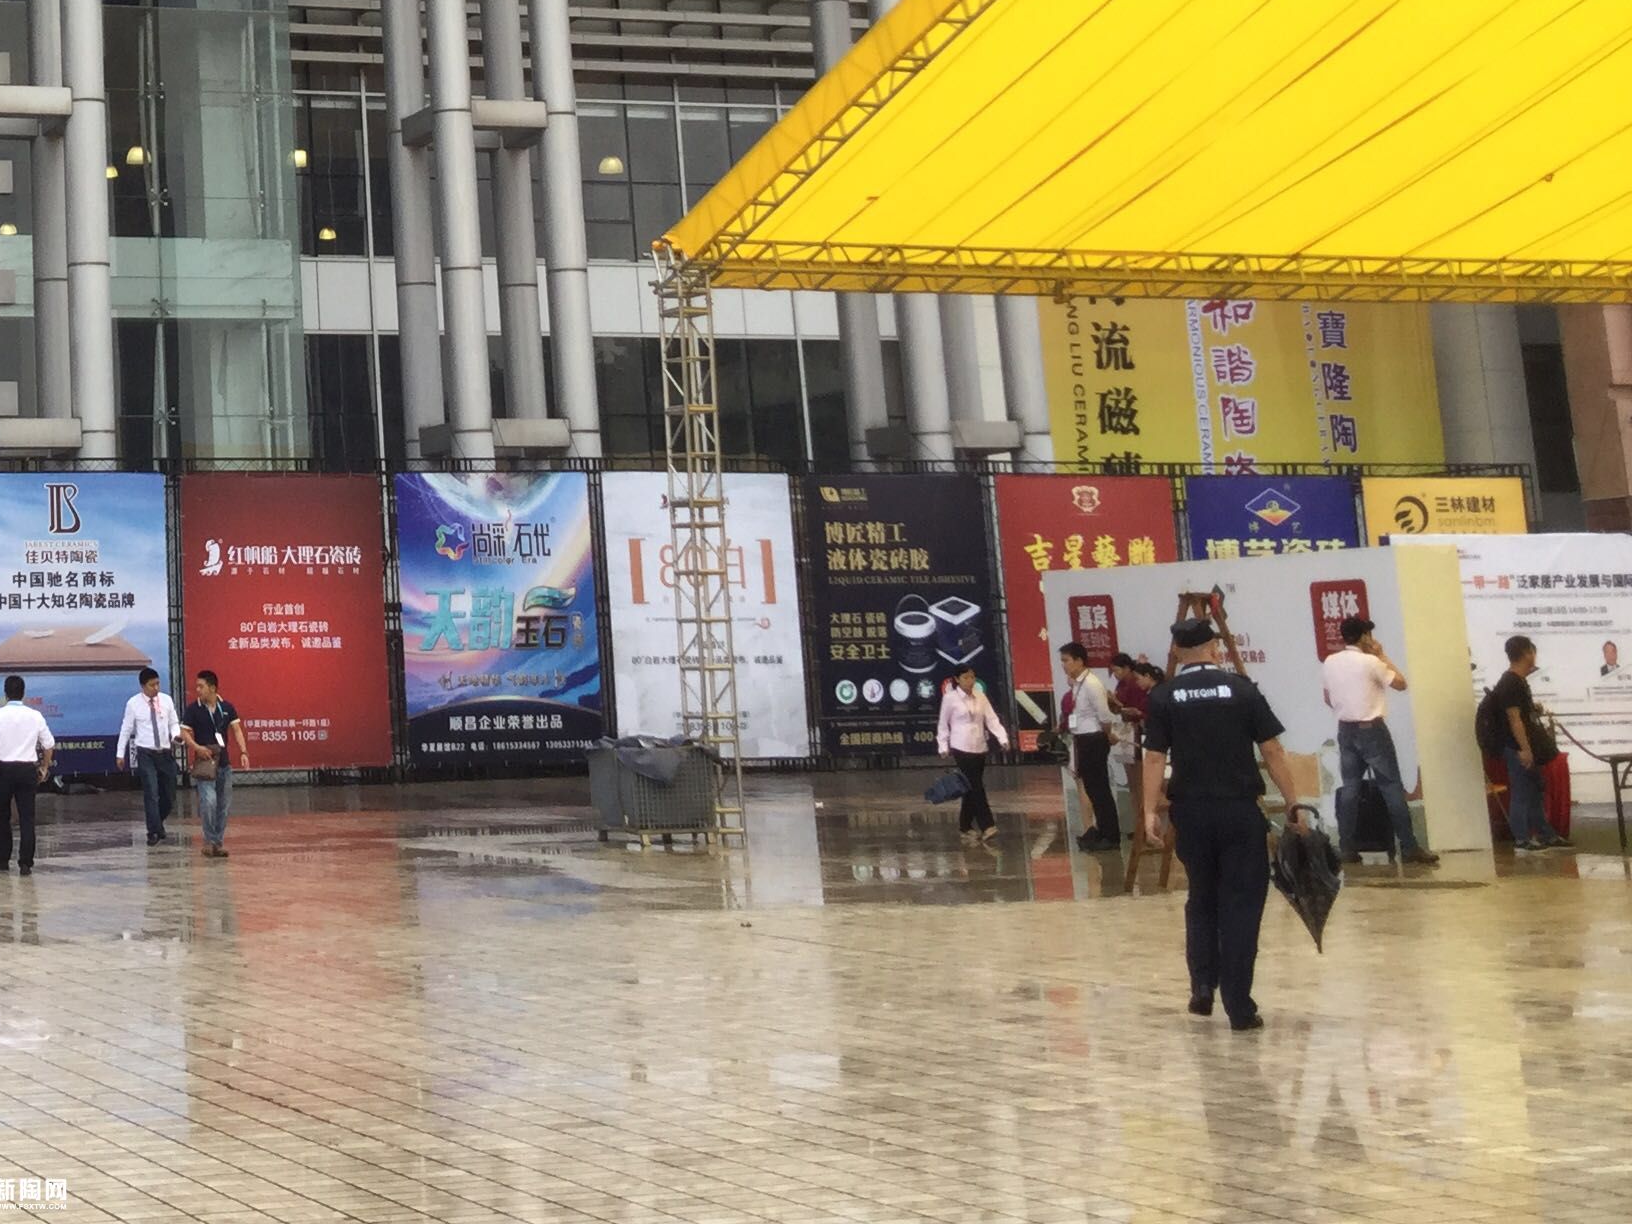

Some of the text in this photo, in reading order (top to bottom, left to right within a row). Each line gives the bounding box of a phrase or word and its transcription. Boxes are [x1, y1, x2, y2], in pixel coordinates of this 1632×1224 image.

[1069, 342, 1083, 376] LIU
[1434, 495, 1496, 513] 三林建材
[824, 521, 908, 544] 博匠精工
[25, 550, 99, 564] 佳贝特陶瓷
[227, 544, 363, 566] 红帆船 大理石瓷砖
[826, 547, 931, 571] 液体瓷砖胶
[12, 571, 116, 588] 中国驰名商标
[262, 604, 305, 616] 行业首创
[1320, 590, 1360, 620] 媒体
[829, 612, 862, 624] 大理石
[1076, 604, 1109, 630] 嘉宾
[830, 643, 892, 661] 安全卫士
[448, 714, 564, 732] 顺昌企业荣誉出品
[261, 730, 288, 742] 8355
[291, 729, 316, 742] 1105
